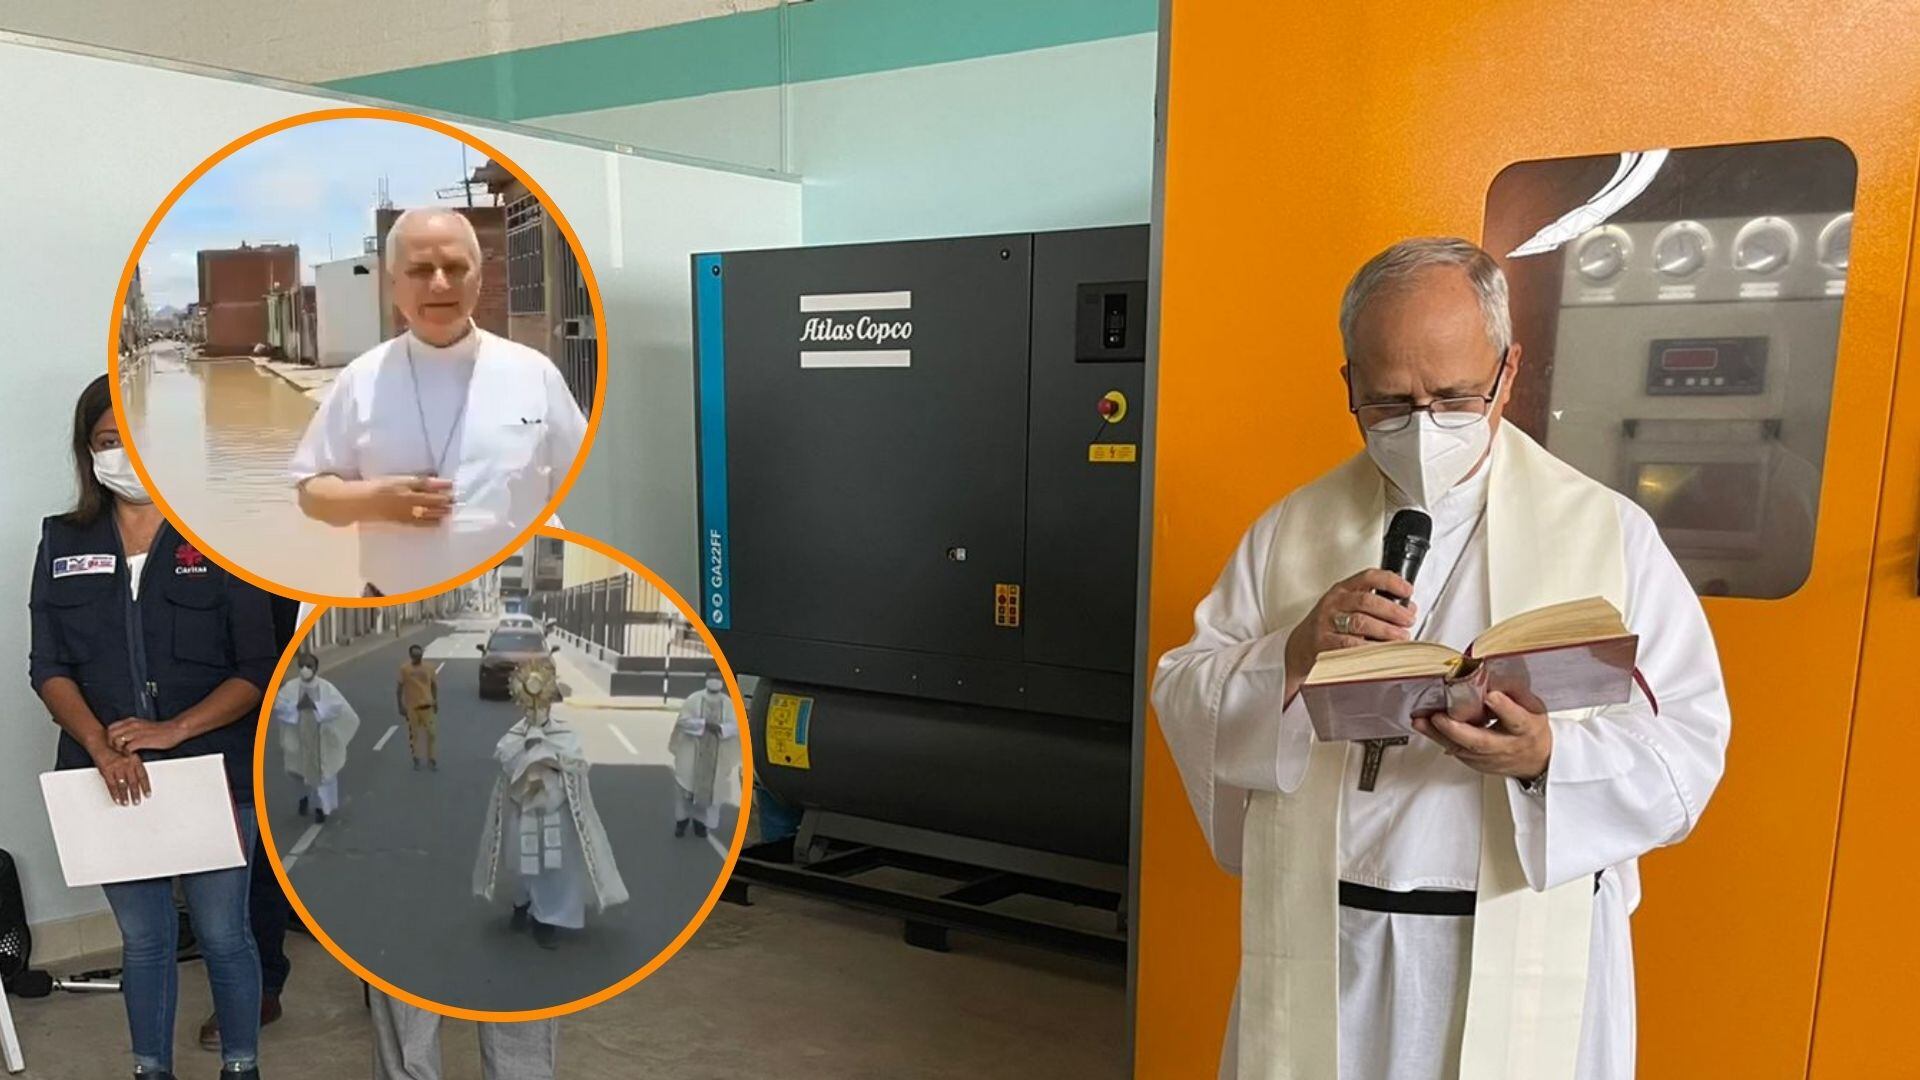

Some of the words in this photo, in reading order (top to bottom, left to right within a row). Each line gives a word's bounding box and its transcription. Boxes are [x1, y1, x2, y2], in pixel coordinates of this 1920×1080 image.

[800, 317, 854, 341] Atlas
[857, 316, 912, 344] Copco
[710, 529, 723, 588] GA22FF
